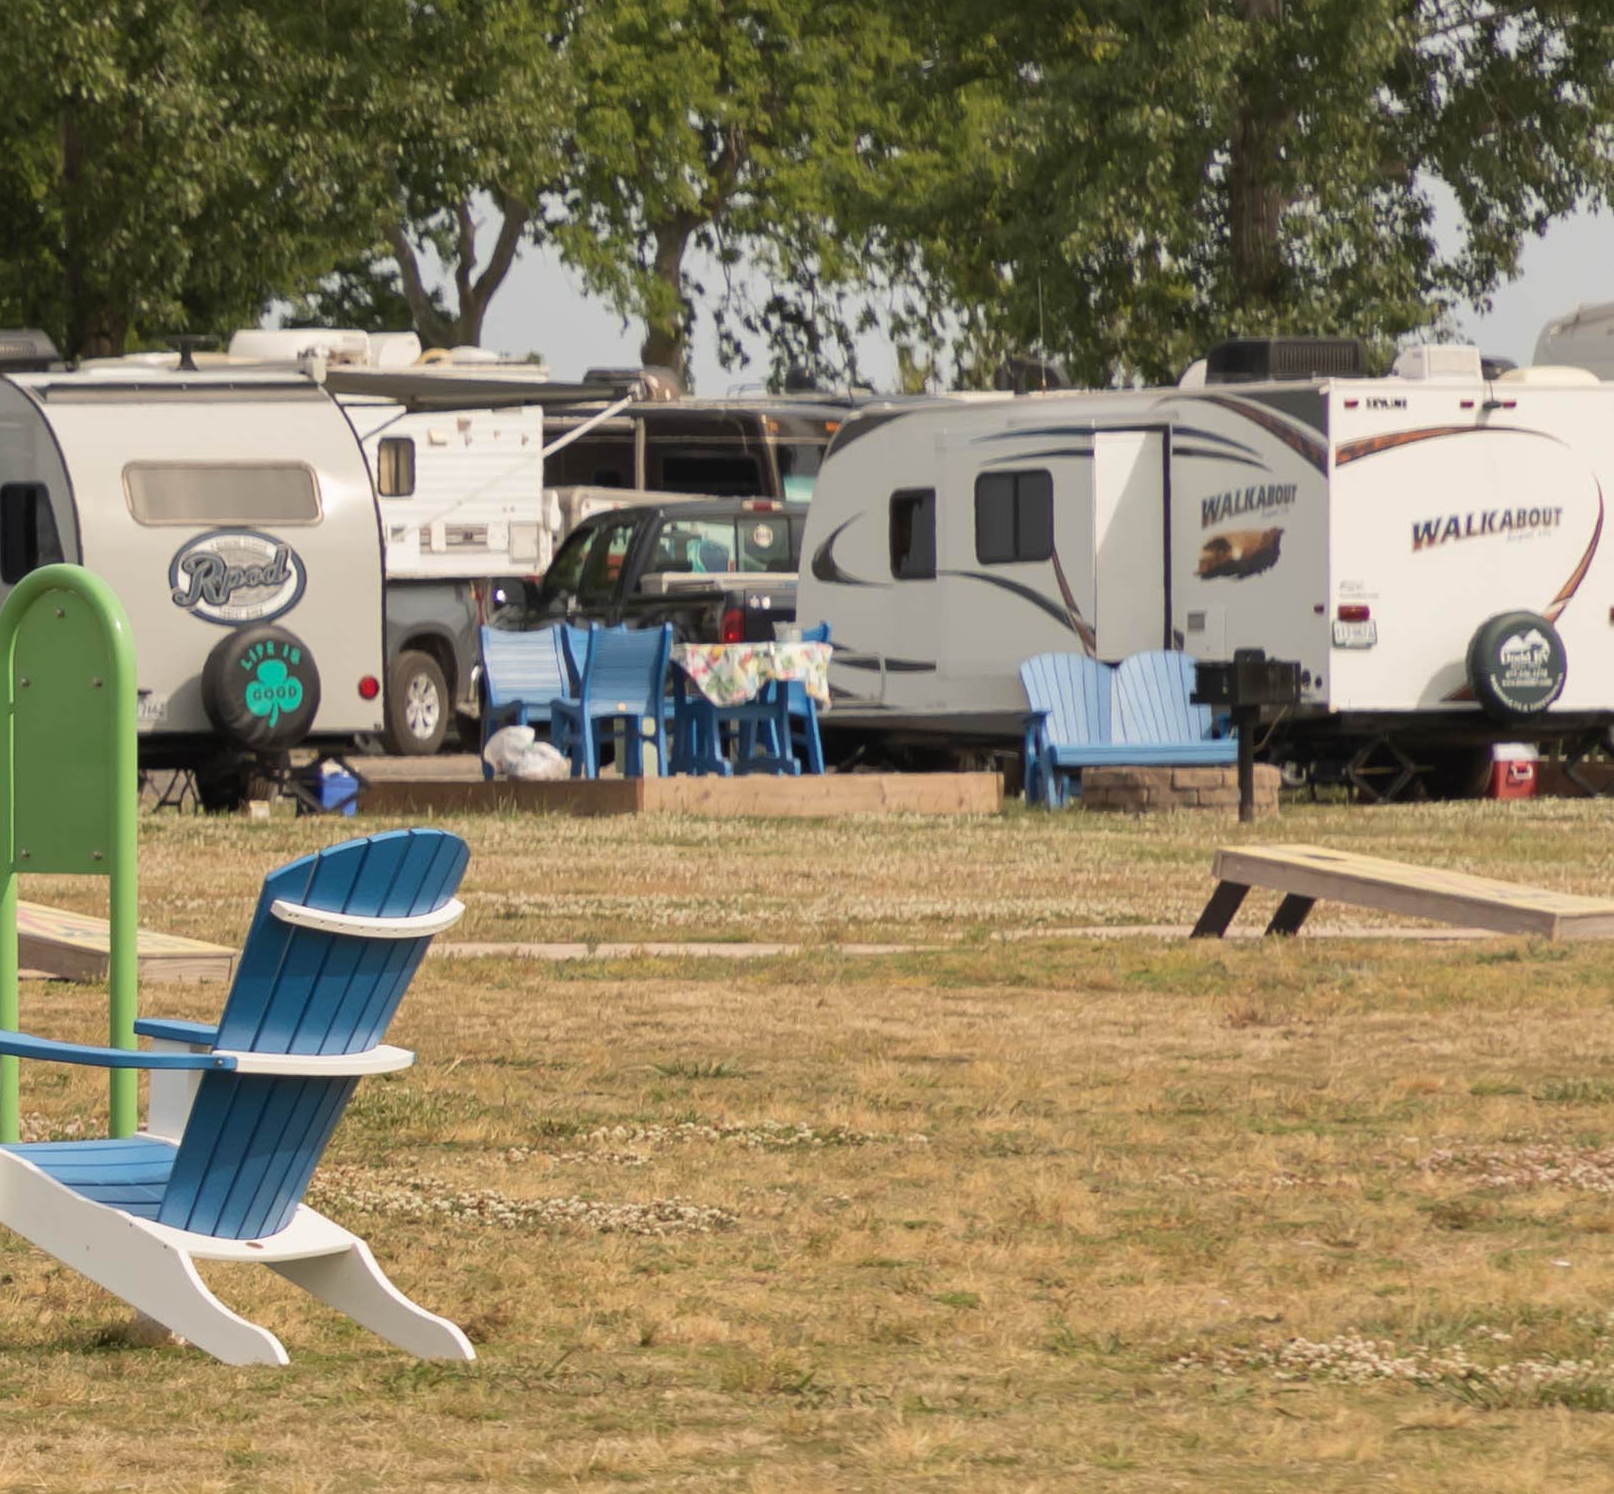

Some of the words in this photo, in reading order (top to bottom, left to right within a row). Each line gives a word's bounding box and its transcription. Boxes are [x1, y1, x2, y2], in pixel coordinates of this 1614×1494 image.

[1201, 483, 1297, 530] WALKABOUT
[1412, 506, 1563, 552] WALKABOUT
[252, 685, 298, 702] GOOD
